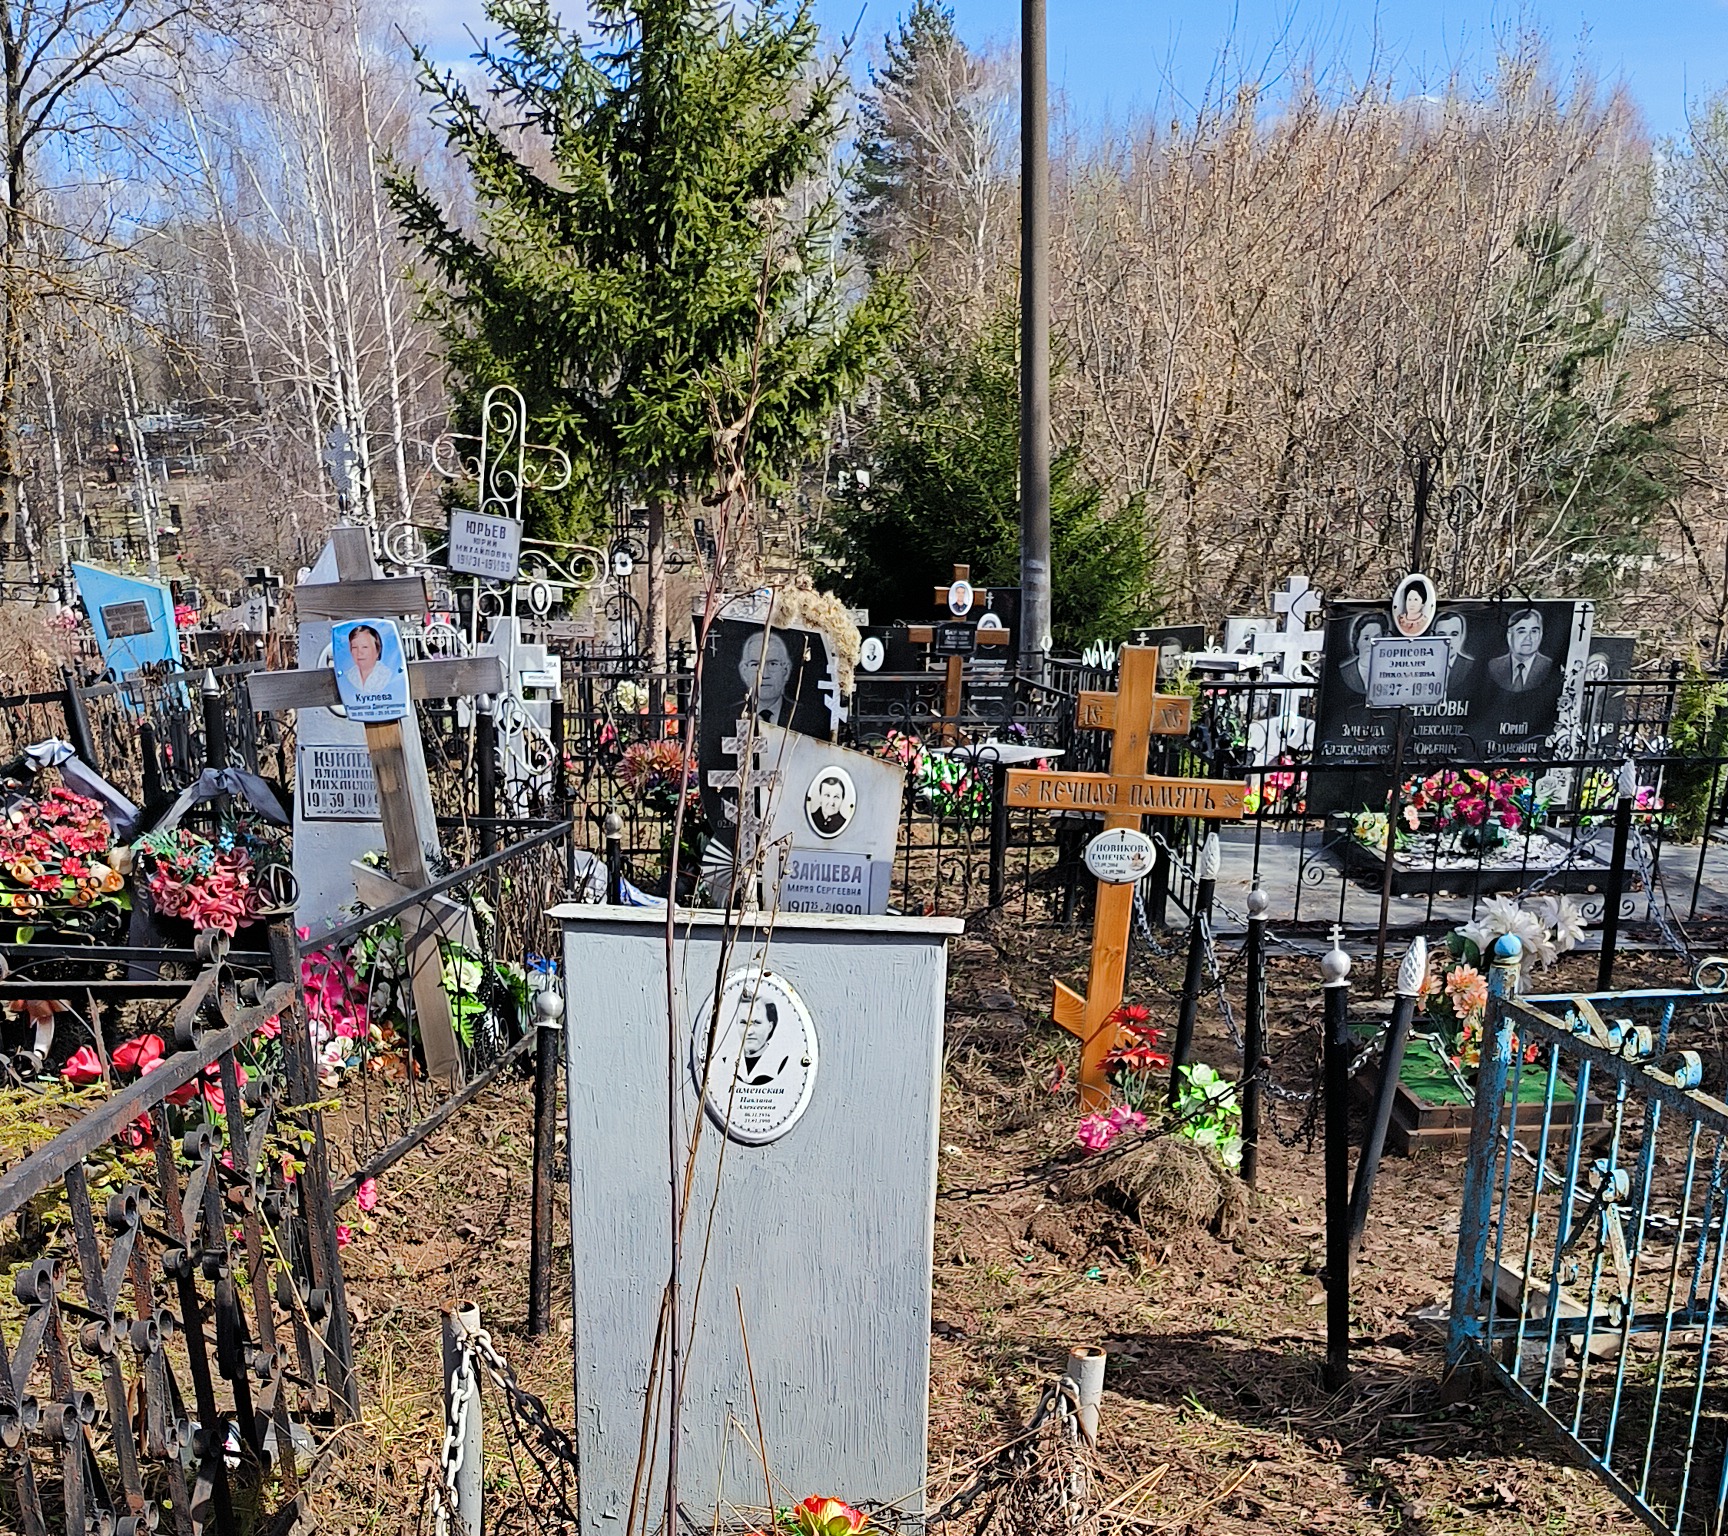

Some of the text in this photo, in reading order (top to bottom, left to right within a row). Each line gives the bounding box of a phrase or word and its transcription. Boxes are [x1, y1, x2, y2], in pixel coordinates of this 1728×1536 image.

[466, 520, 507, 539] ЮРЬЕВ
[1379, 648, 1434, 658] БОРИСОВА
[355, 693, 393, 704] Куклева
[1499, 721, 1529, 735] ЮРИЙ
[315, 768, 373, 778] ВЛАДИМИ
[1038, 780, 1216, 811] ВЕЧНАЯ ПАМЯТЬ
[1096, 844, 1149, 852] НОВИКОВА
[1091, 853, 1131, 861] ТАНЕЧКА
[790, 860, 862, 883] ЗАЙЦЕВА
